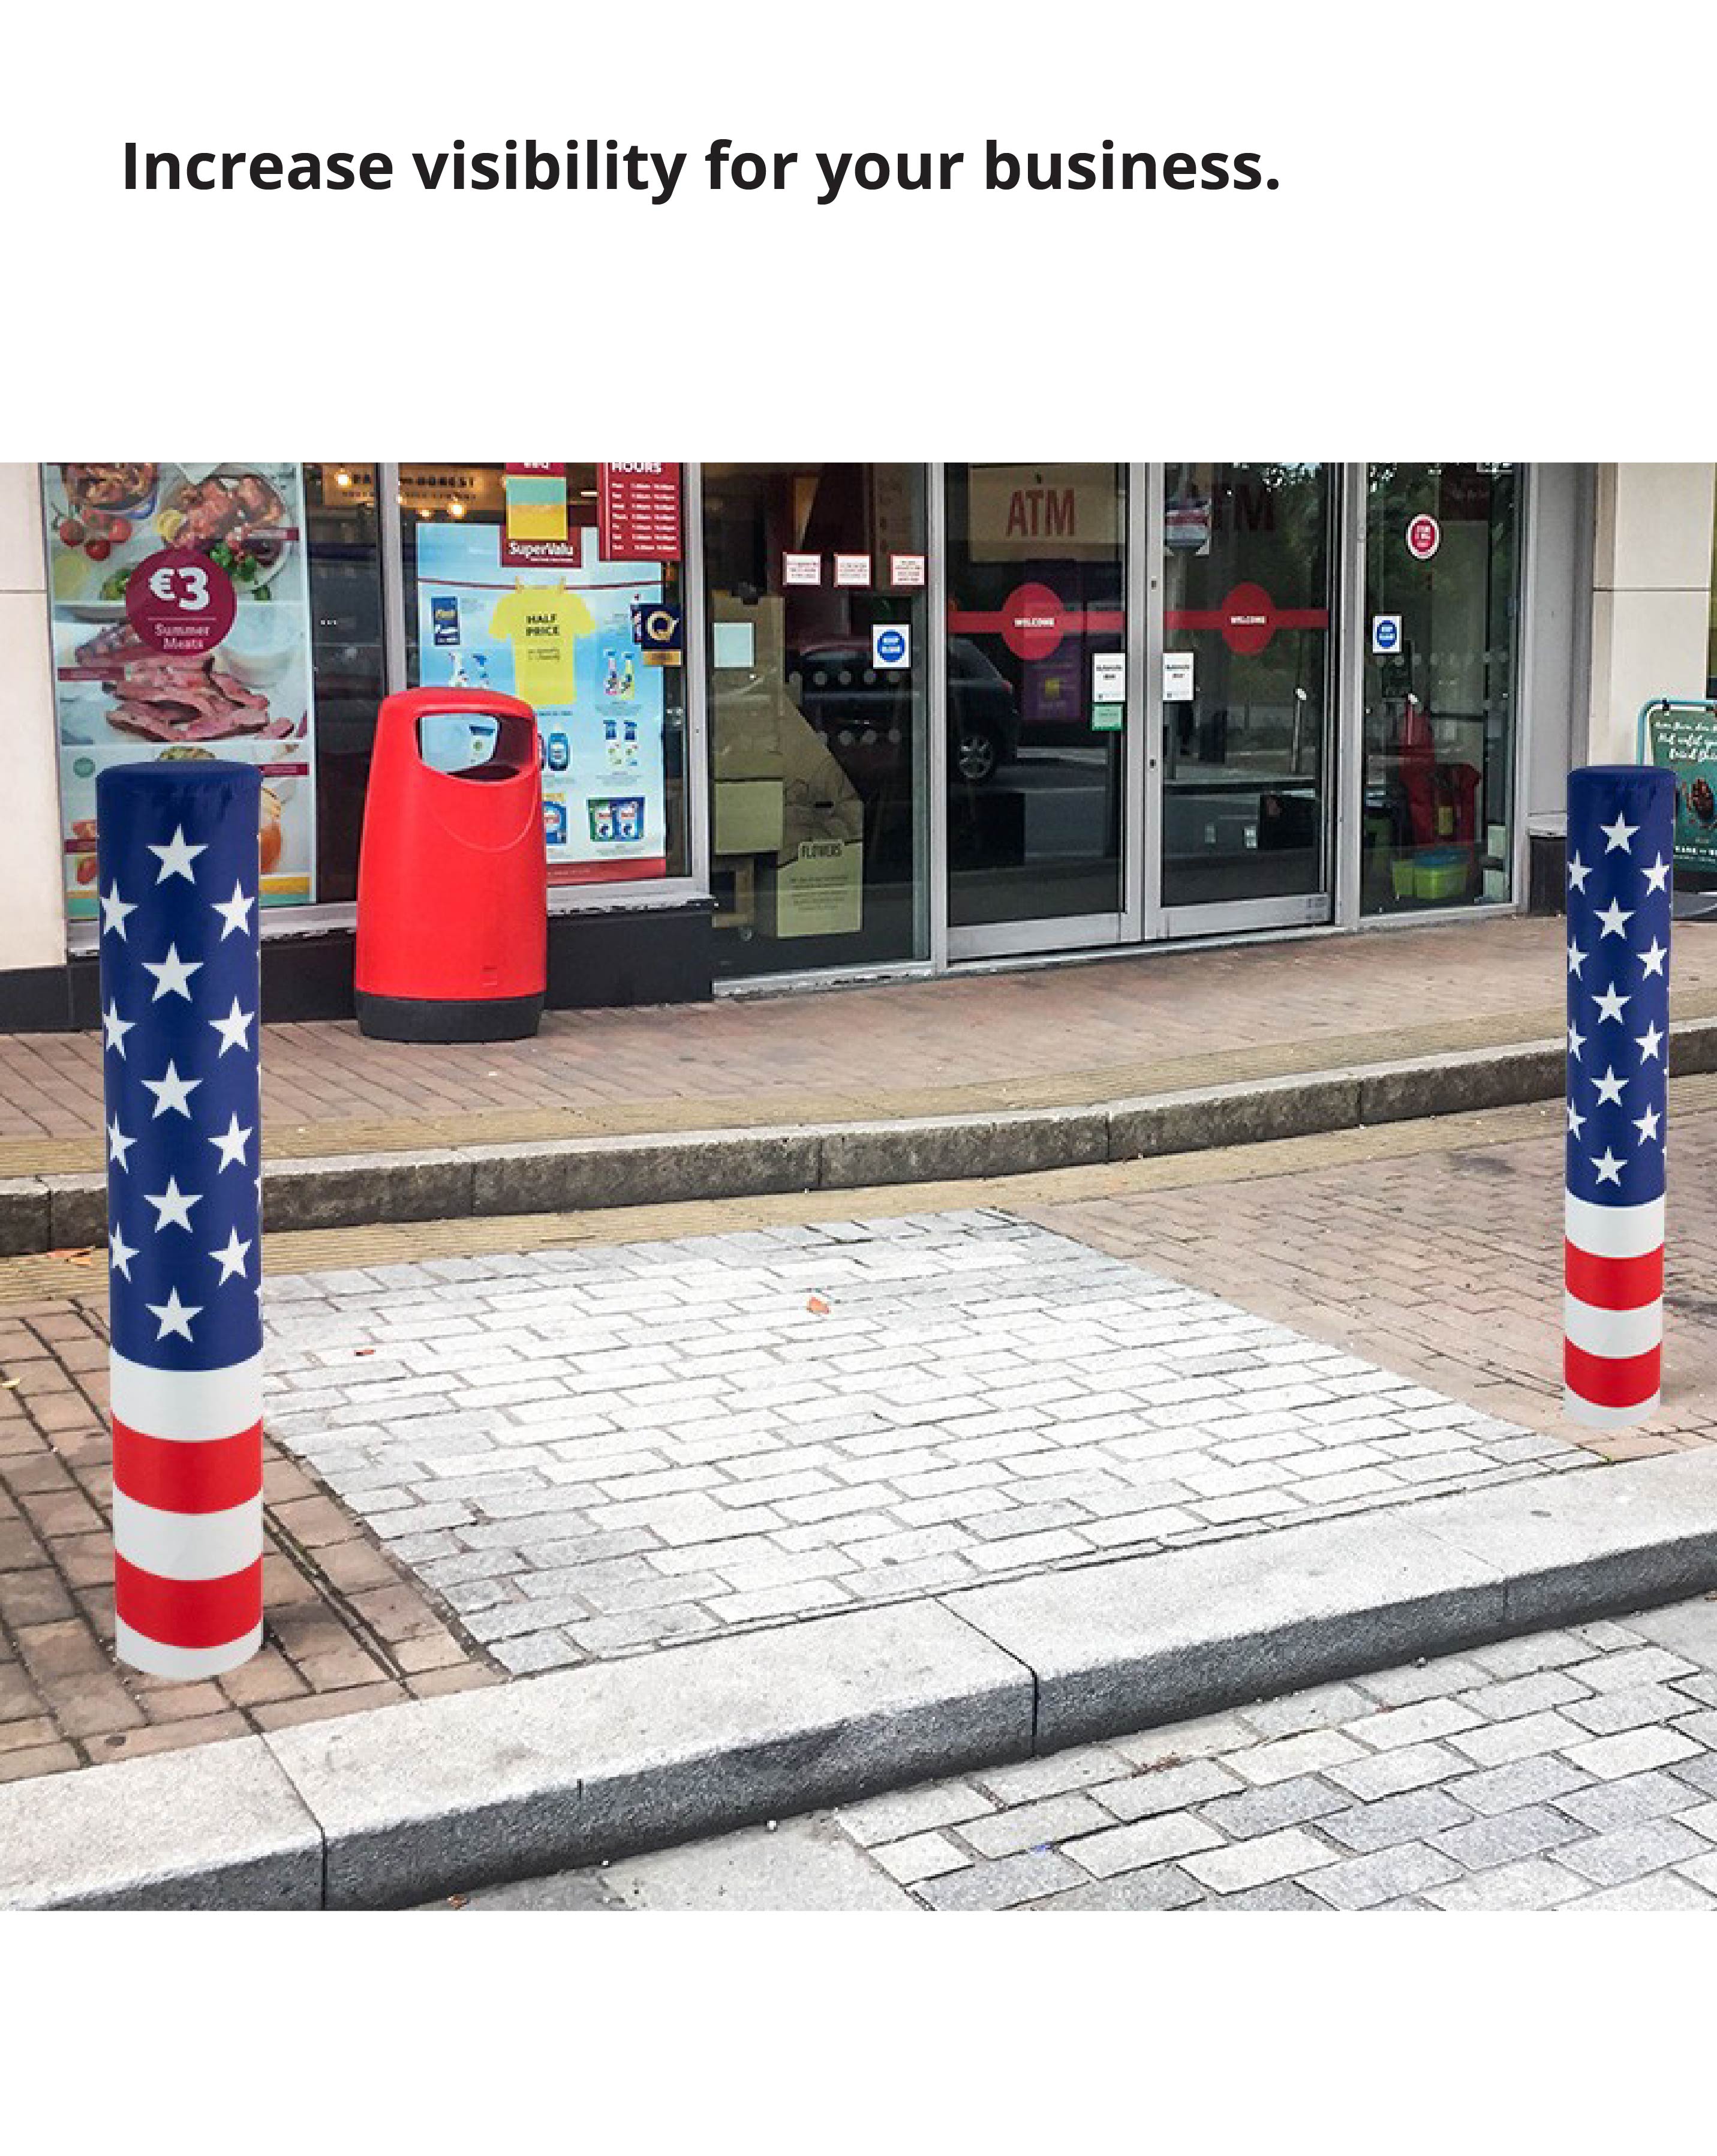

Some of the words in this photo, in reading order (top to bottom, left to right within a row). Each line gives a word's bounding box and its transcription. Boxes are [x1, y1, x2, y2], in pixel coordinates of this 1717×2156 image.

[1006, 487, 1075, 538] ATM
[508, 540, 573, 558] SuperValu
[148, 567, 210, 611] €3
[525, 614, 558, 624] HALF
[1014, 617, 1055, 627] WELCOME
[1230, 615, 1267, 625] WELCOME
[154, 623, 210, 636] Summer
[525, 626, 560, 636] PRICE
[163, 638, 204, 649] Meats
[801, 842, 843, 859] FLOWERS
